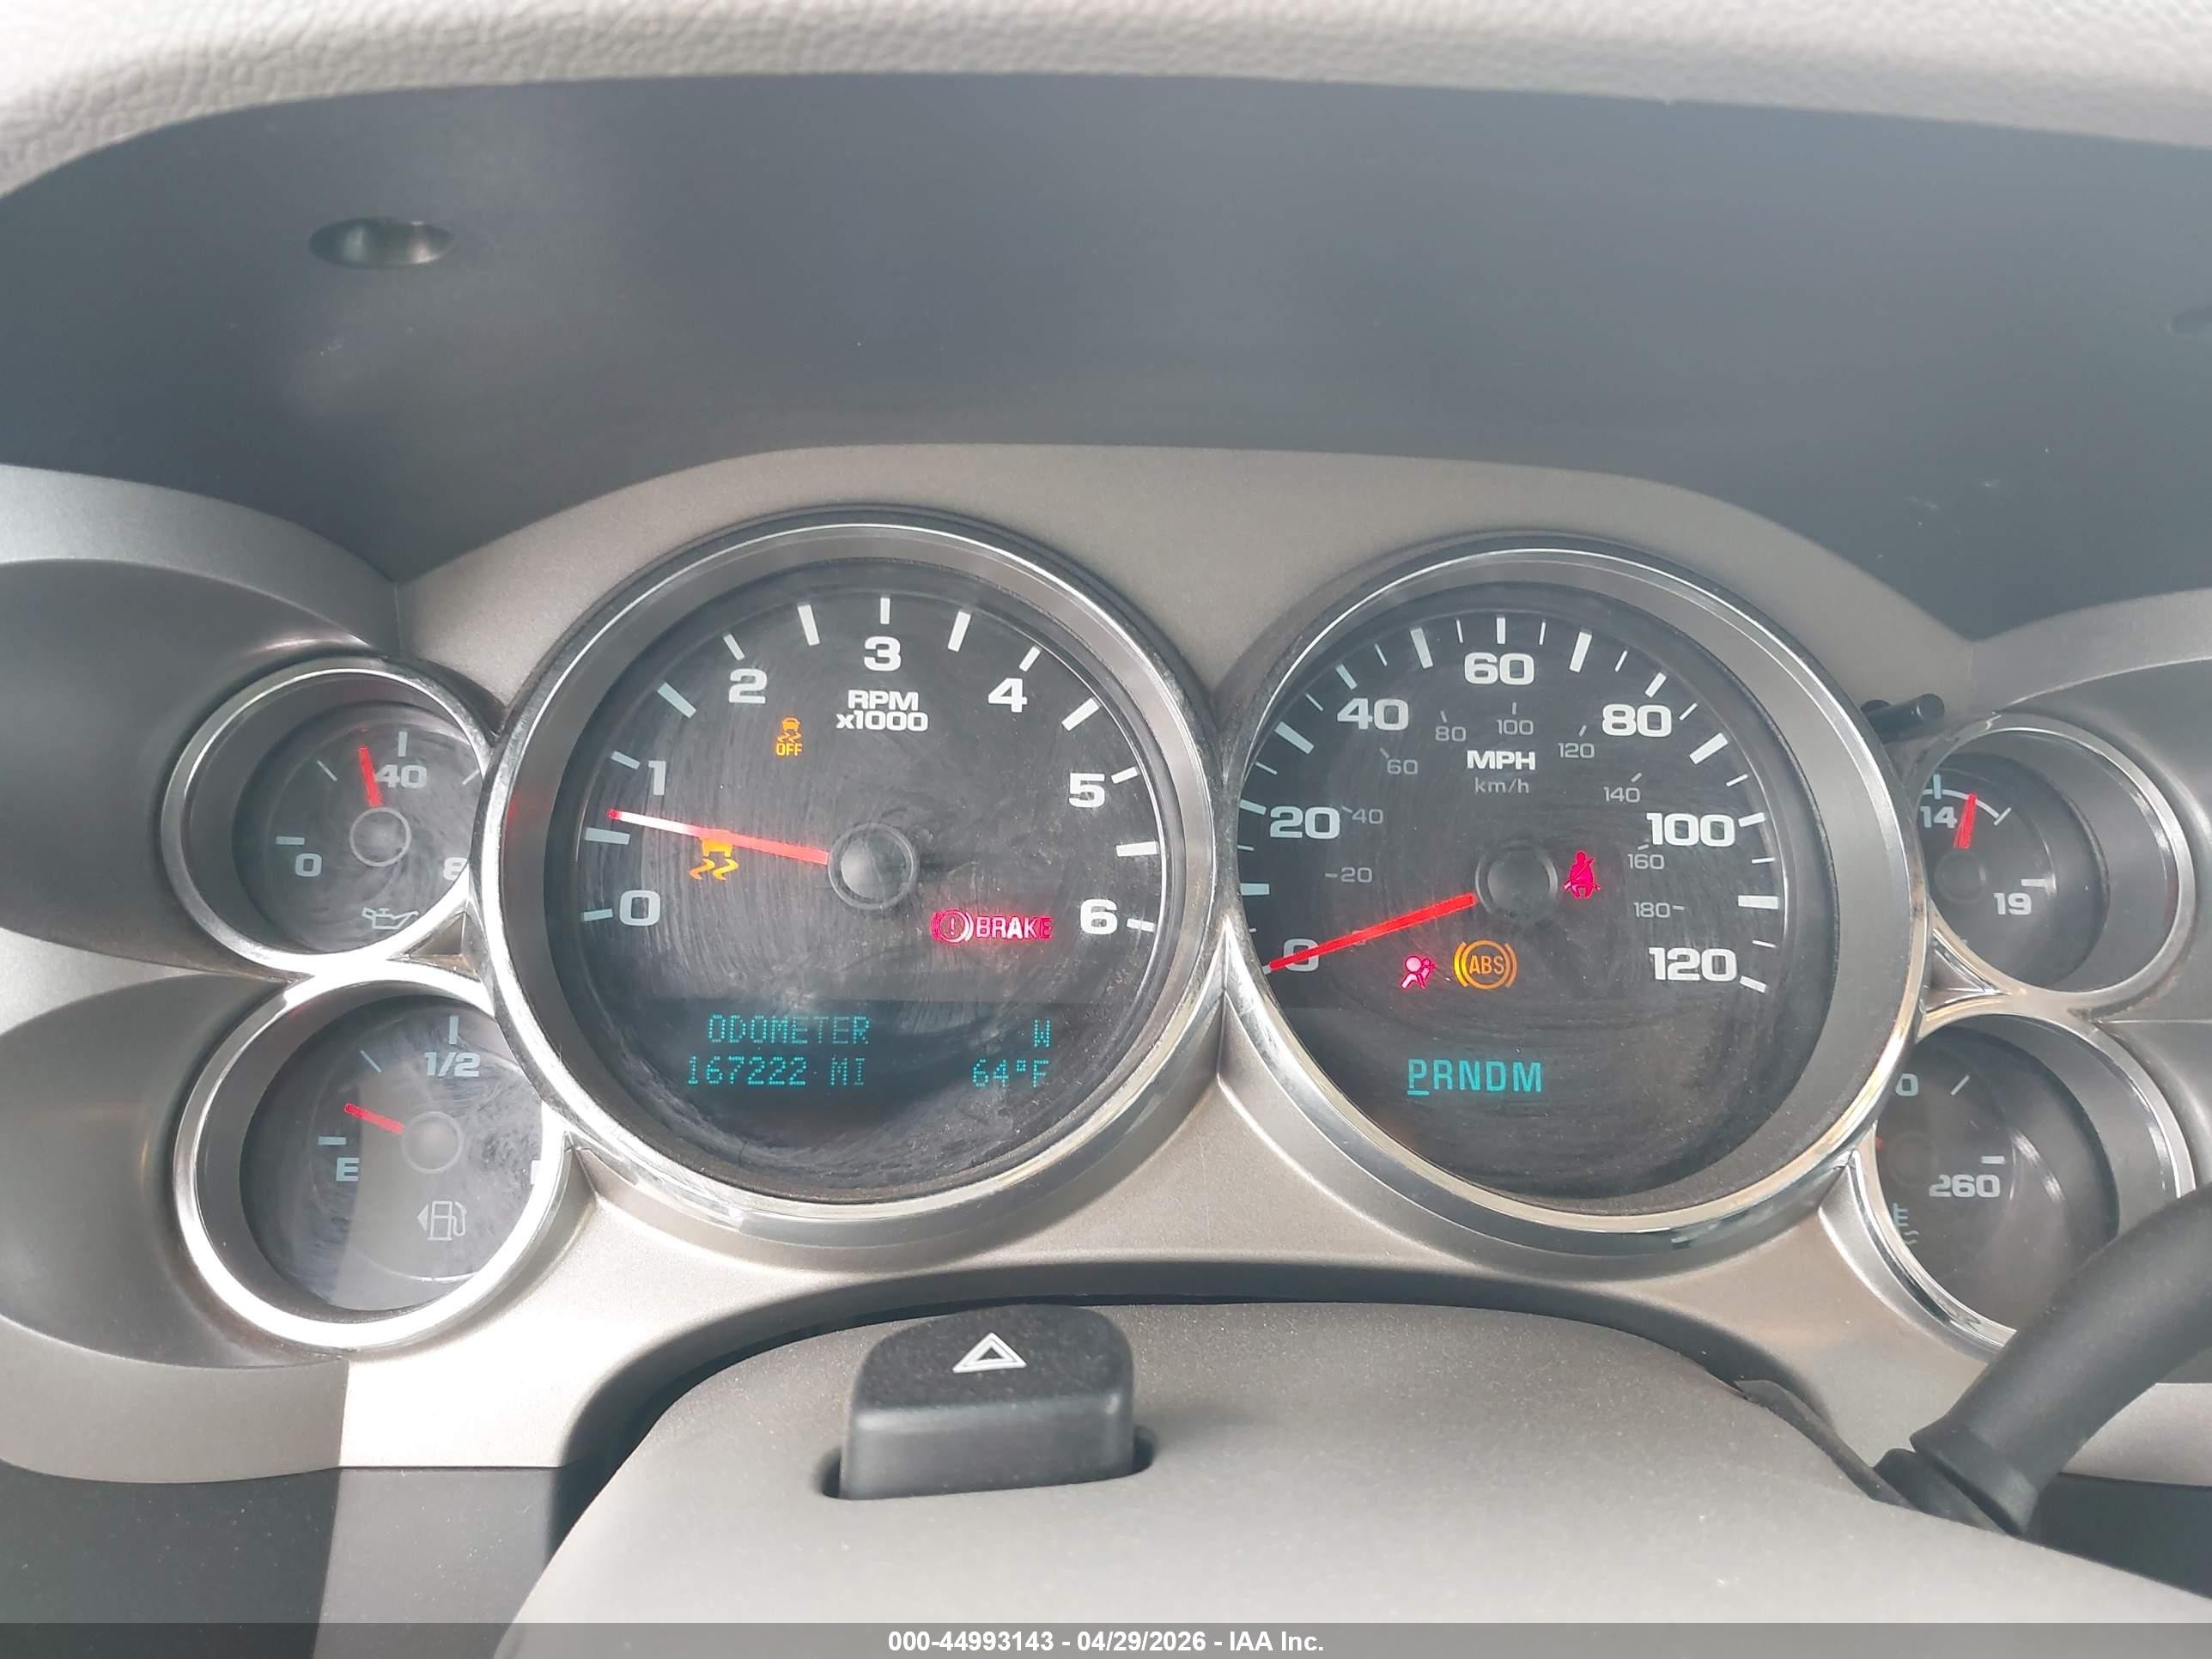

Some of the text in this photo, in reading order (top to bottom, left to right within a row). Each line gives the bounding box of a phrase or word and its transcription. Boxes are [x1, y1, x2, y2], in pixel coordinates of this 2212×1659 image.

[864, 636, 901, 671] 3
[1464, 652, 1534, 684] 60
[729, 668, 767, 704] 2
[988, 678, 1027, 713] 4
[848, 691, 918, 711] RPM
[836, 711, 928, 731] x1000
[1337, 698, 1408, 730] 40
[1602, 704, 1672, 736] 80
[1435, 726, 1466, 743] 80
[1496, 720, 1534, 735] 100
[775, 743, 802, 756] OFF
[1467, 750, 1535, 770] MPH
[1558, 743, 1595, 759] 120
[374, 764, 427, 788] 40
[649, 761, 665, 795] 1
[1387, 759, 1418, 775] 60
[1069, 773, 1104, 808] 5
[1474, 777, 1529, 794] km/h
[1604, 787, 1640, 802] 140
[1269, 805, 1340, 839] 20
[1352, 808, 1383, 824] 40
[1920, 806, 1957, 829] 14
[1646, 812, 1735, 847] 100
[295, 854, 322, 877] 0
[1628, 854, 1664, 870] 160
[1340, 867, 1372, 884] 20
[619, 890, 660, 926] 0
[1633, 902, 1670, 918] 180
[1994, 893, 2032, 915] 19
[975, 916, 1053, 940] BRAKE
[1079, 899, 1117, 934] 6
[1283, 939, 1319, 972] 0
[1469, 956, 1504, 974] ABS
[1649, 947, 1736, 981] 120
[708, 1014, 871, 1046] ODOMETER
[1033, 1017, 1051, 1048] W
[424, 1052, 479, 1078] 1/2
[687, 1055, 866, 1087] 167222 MI
[1407, 1059, 1542, 1094] PRNDM
[336, 1158, 359, 1182] E
[1929, 1175, 2000, 1198] 260
